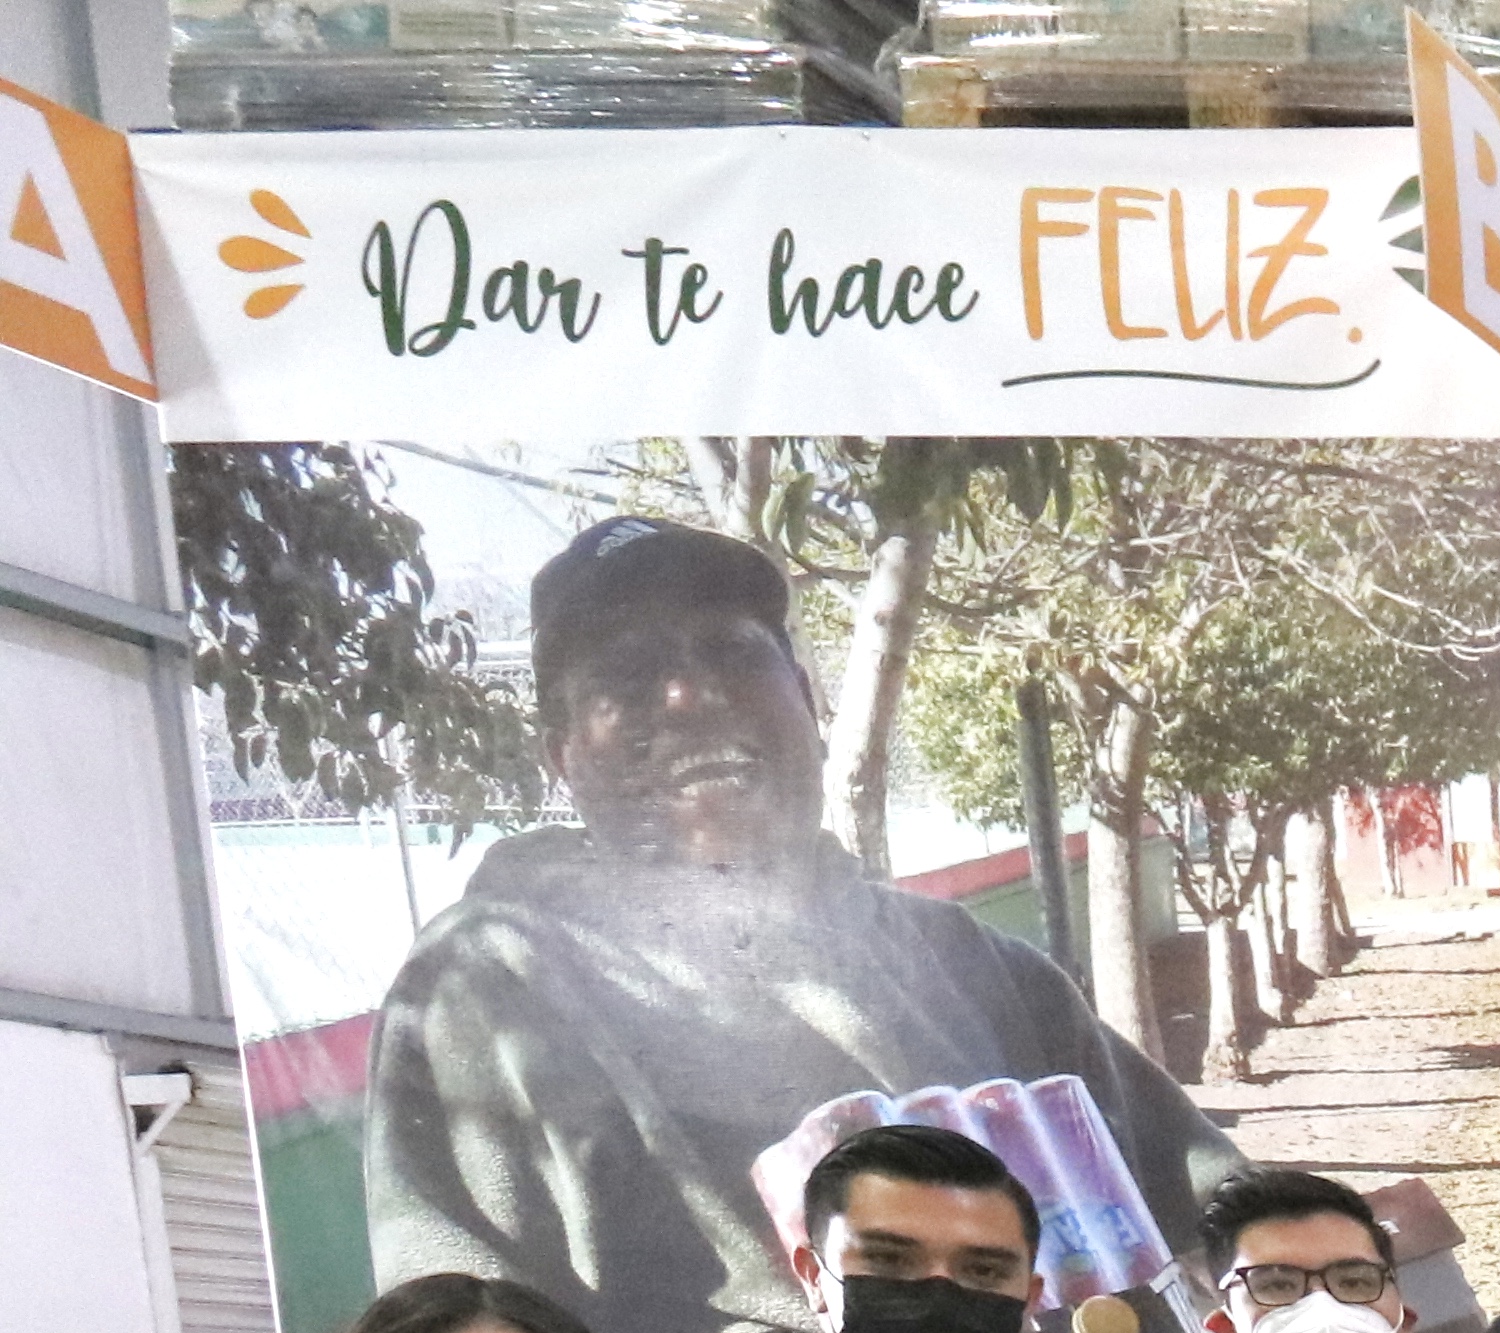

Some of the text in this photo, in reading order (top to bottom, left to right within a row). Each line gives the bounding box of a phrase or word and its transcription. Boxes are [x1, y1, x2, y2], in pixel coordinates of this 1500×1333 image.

[0, 92, 153, 384] A
[362, 199, 601, 357] Dar
[621, 237, 723, 346] te
[767, 227, 980, 338] hace
